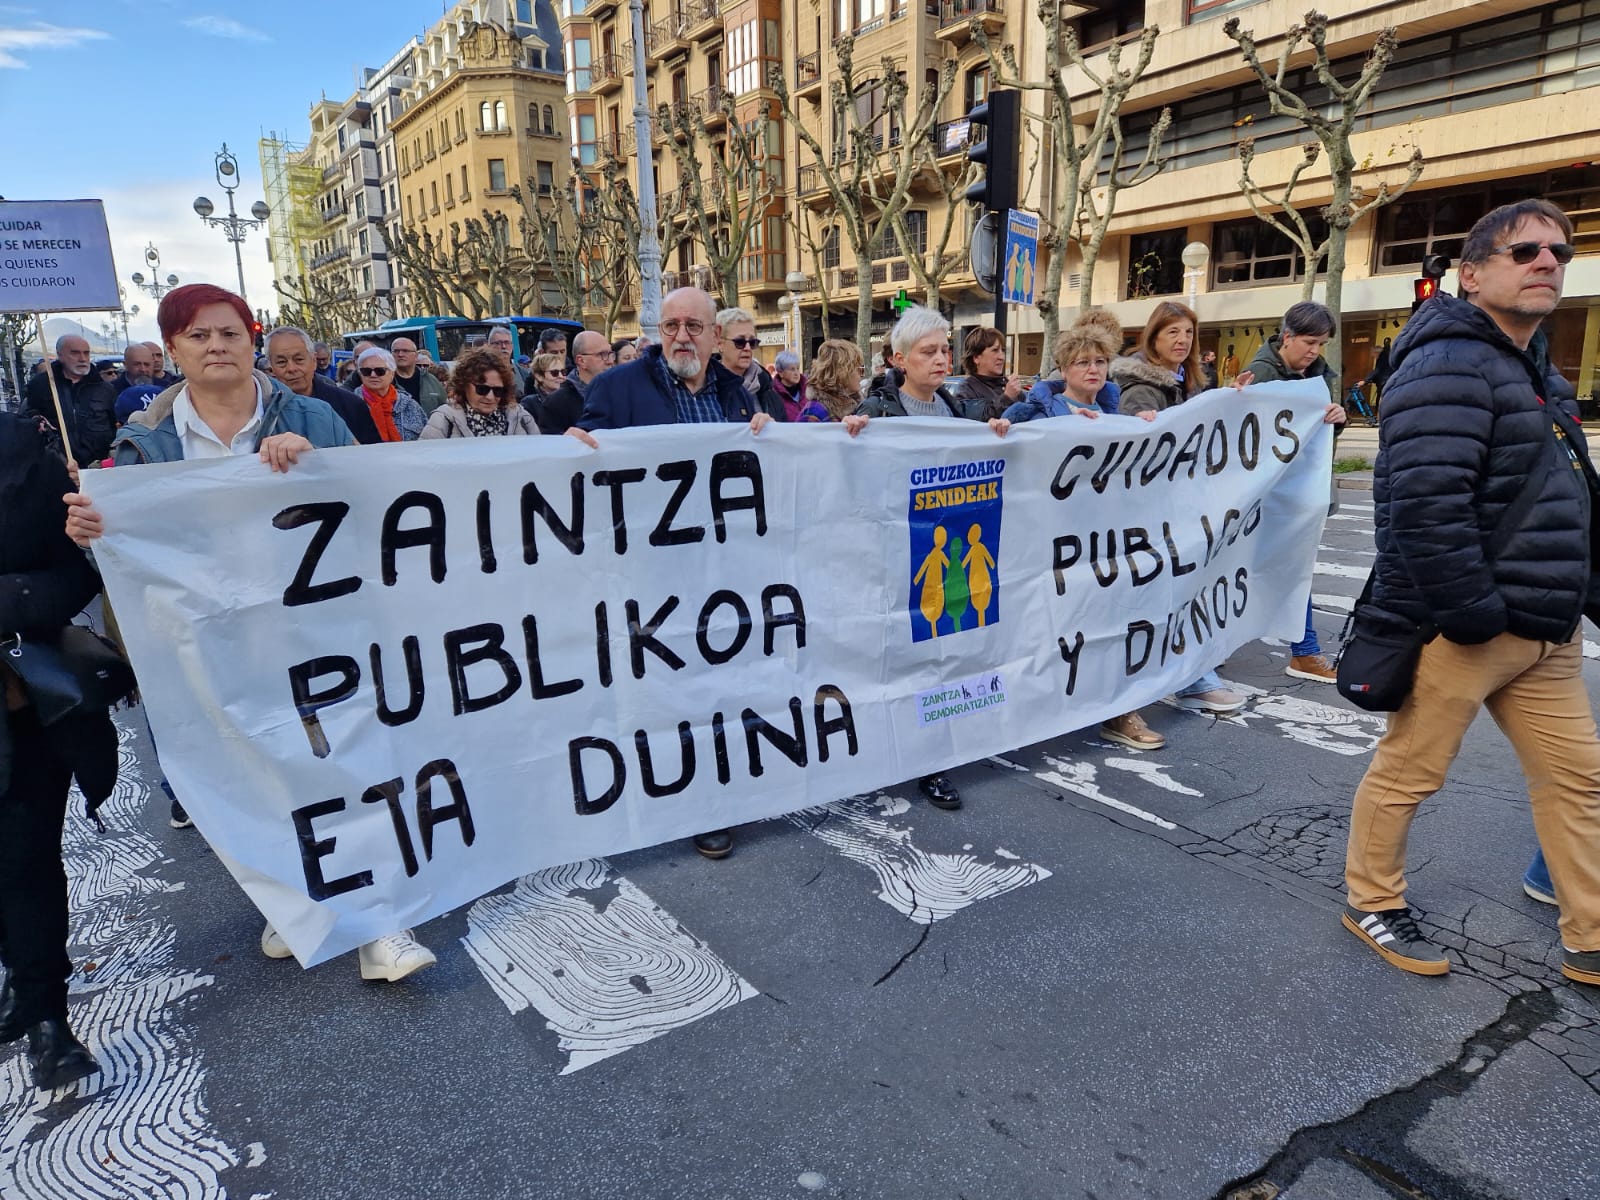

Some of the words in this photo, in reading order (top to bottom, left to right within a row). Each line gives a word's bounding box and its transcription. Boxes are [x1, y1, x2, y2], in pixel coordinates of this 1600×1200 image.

[5, 240, 19, 250] SE
[22, 239, 81, 250] MERECEN
[5, 259, 58, 270] QUIENES
[11, 277, 75, 287] CUIDARON
[910, 459, 1006, 485] GIPUZKOAKO
[1050, 409, 1301, 500] CUIDADOS
[914, 482, 998, 511] SENIDEAK
[273, 450, 767, 606] ZAINTZA
[1053, 498, 1264, 596] PUBLICO
[1058, 631, 1084, 696] Y
[1125, 566, 1249, 676] DIGNOS
[288, 584, 806, 758] PUBLIKOA
[922, 689, 963, 708] ZAINTZA
[291, 759, 475, 900] ETA
[568, 684, 858, 815] DUINA
